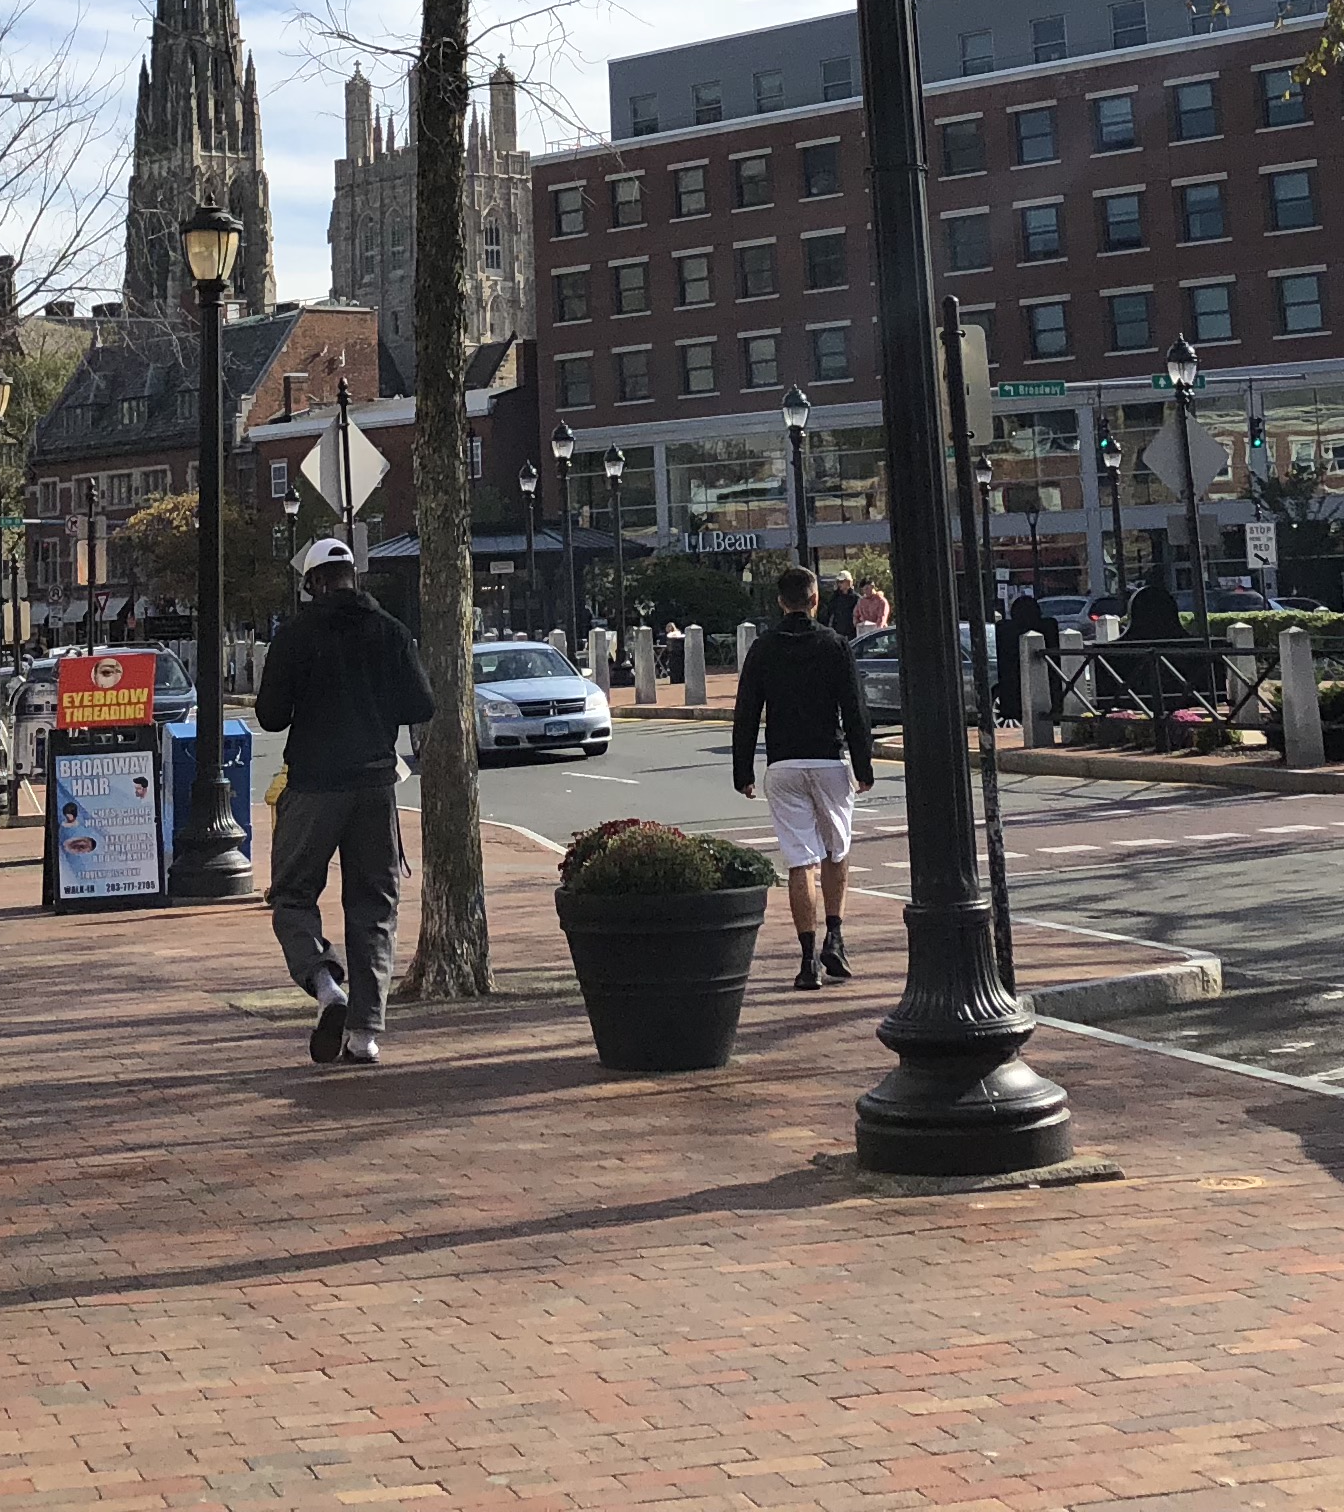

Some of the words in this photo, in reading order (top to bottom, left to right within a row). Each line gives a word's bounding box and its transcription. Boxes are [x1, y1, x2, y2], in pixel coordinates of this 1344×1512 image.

[1019, 385, 1060, 396] Broadway
[1249, 527, 1272, 535] STOP
[684, 531, 757, 553] L.L.Bean
[63, 688, 149, 707] EYEBROW
[64, 704, 145, 723] THREADING
[60, 756, 148, 777] BROADWAY
[71, 777, 110, 797] HAIR
